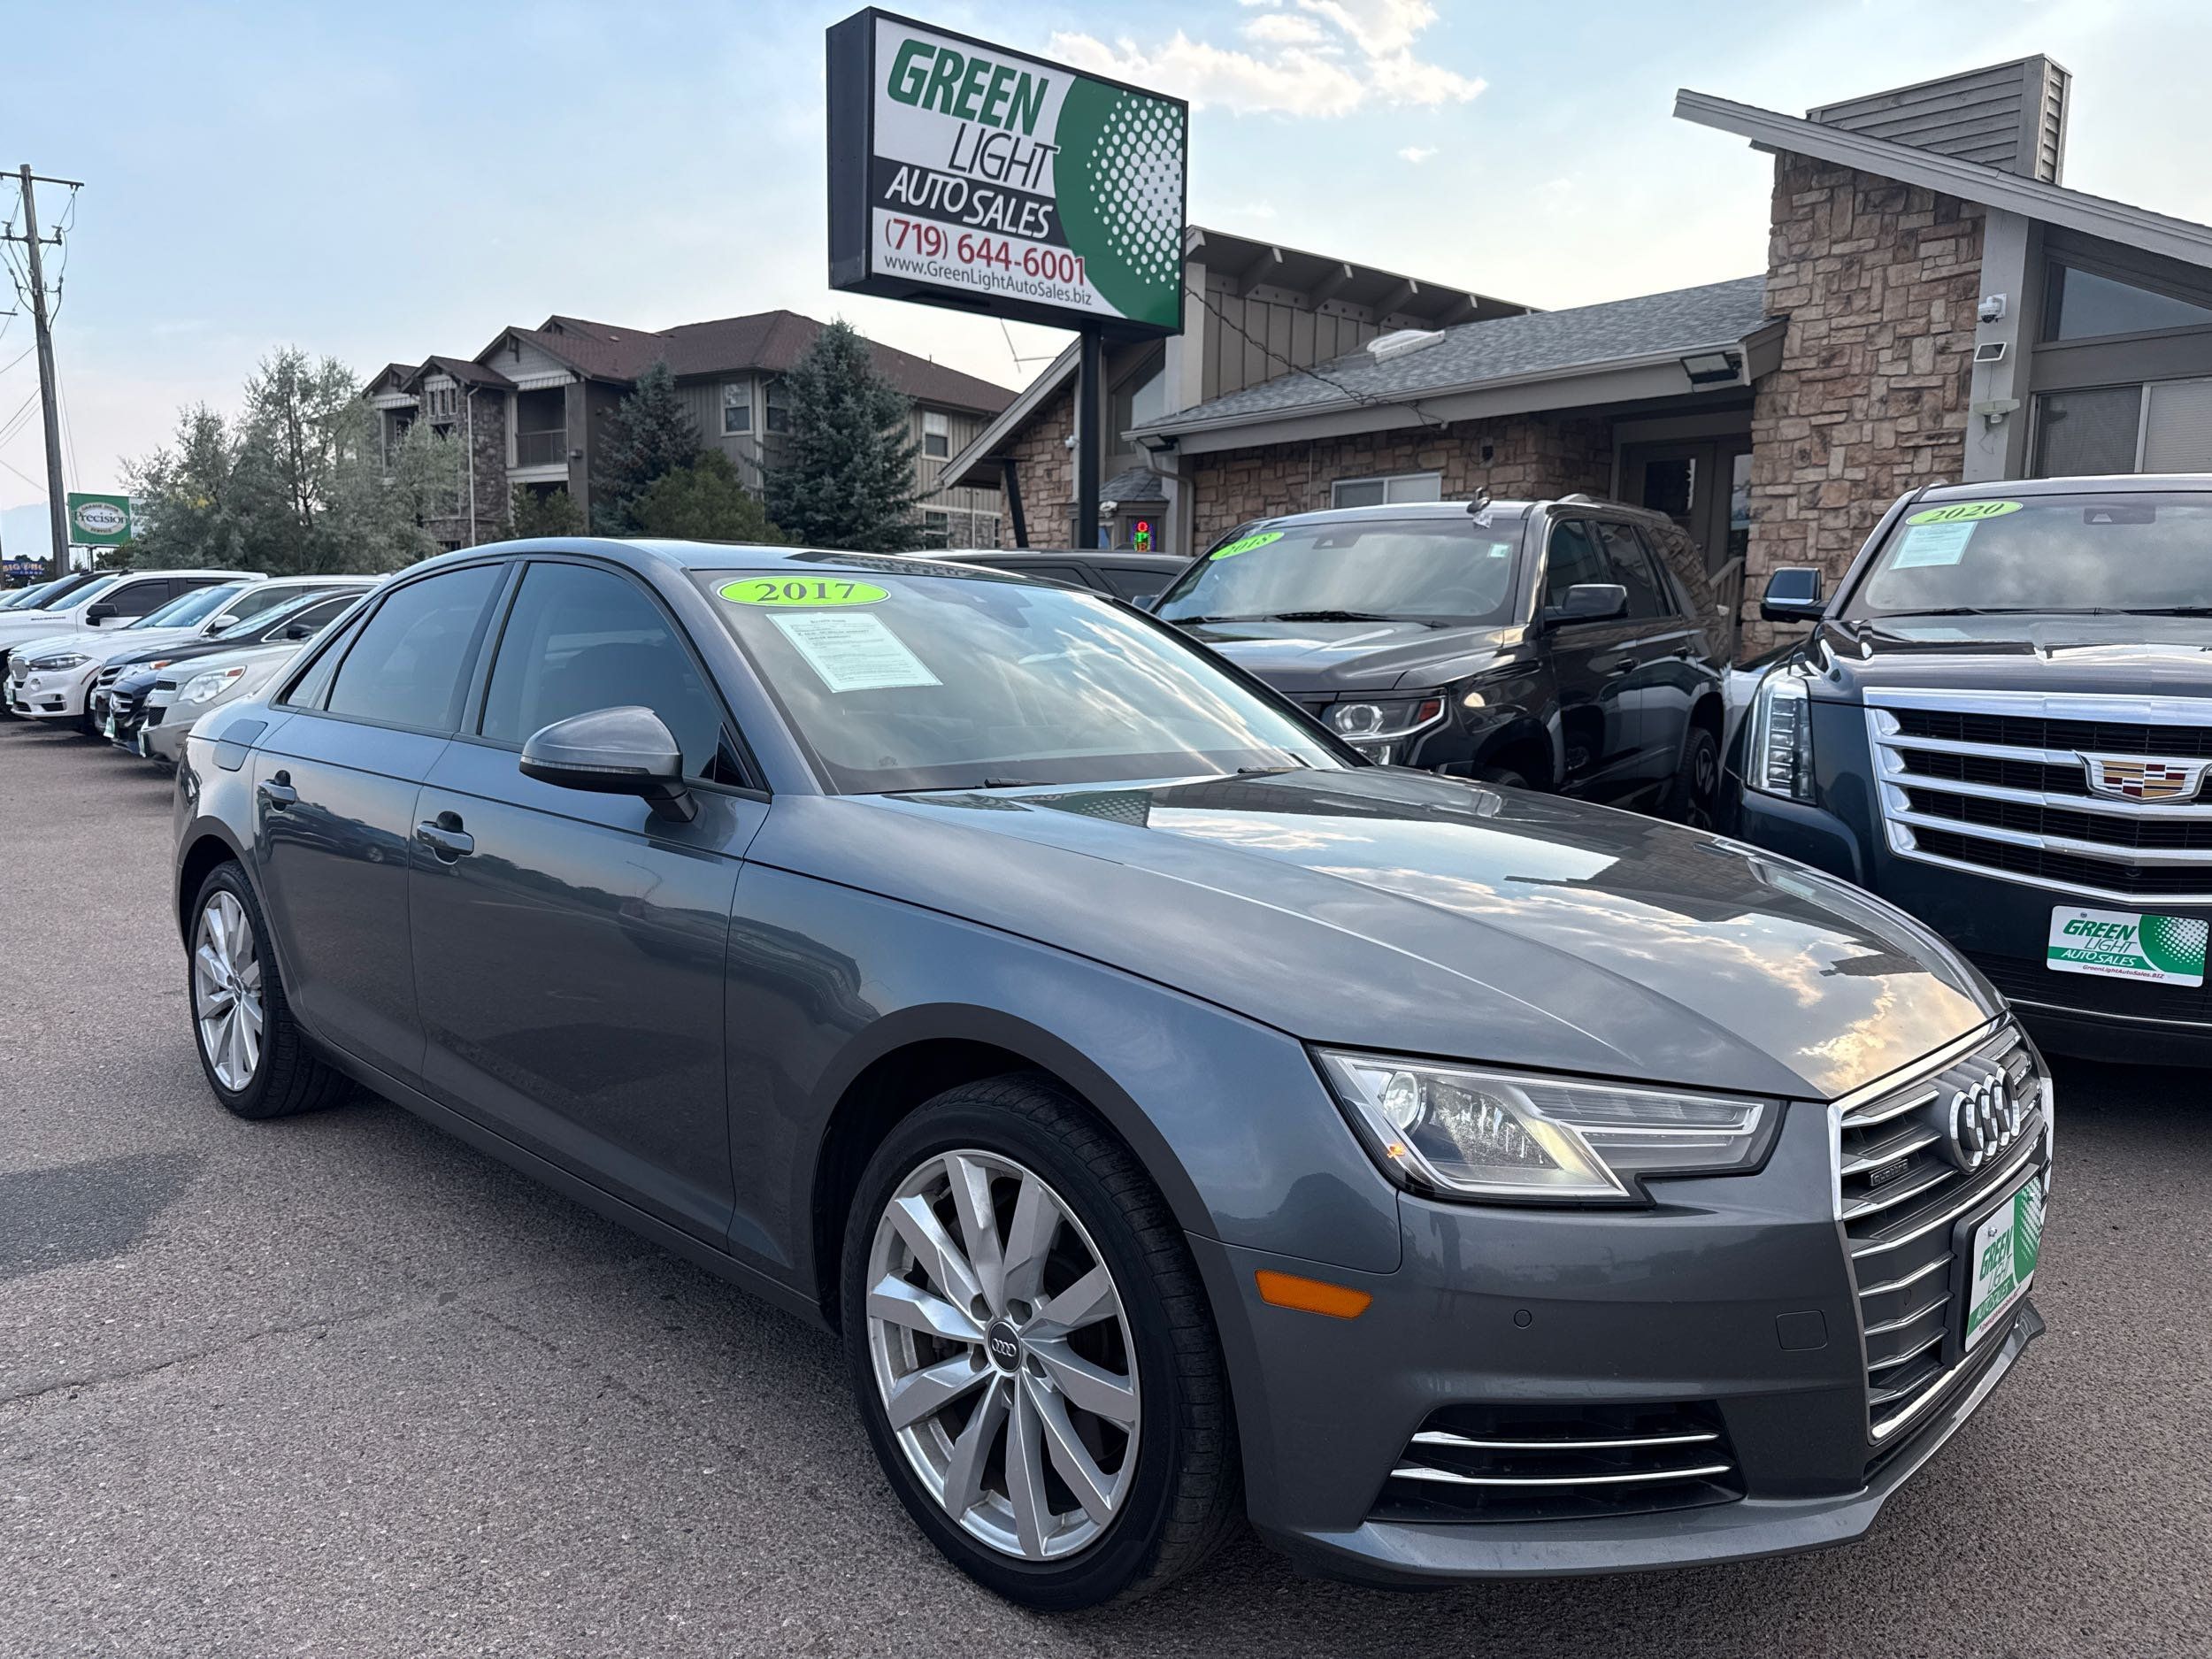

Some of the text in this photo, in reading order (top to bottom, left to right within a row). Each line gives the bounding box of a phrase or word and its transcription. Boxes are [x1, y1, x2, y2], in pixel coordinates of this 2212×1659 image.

[887, 38, 1049, 136] GREEN
[948, 122, 1060, 190] LIGHT
[884, 165, 1054, 239] AUTO SALES
[885, 219, 1086, 286] (719) 644-6001
[885, 255, 1093, 306] www.GreenLightAutoSales.biz
[74, 511, 127, 524] Precision
[1925, 503, 2005, 523] 2020
[755, 582, 856, 602] 2017
[2062, 918, 2138, 941] GREEN
[2084, 937, 2138, 954] LIGHT
[2061, 949, 2137, 967] AUTO SALES
[1979, 1225, 2014, 1281] GREEN
